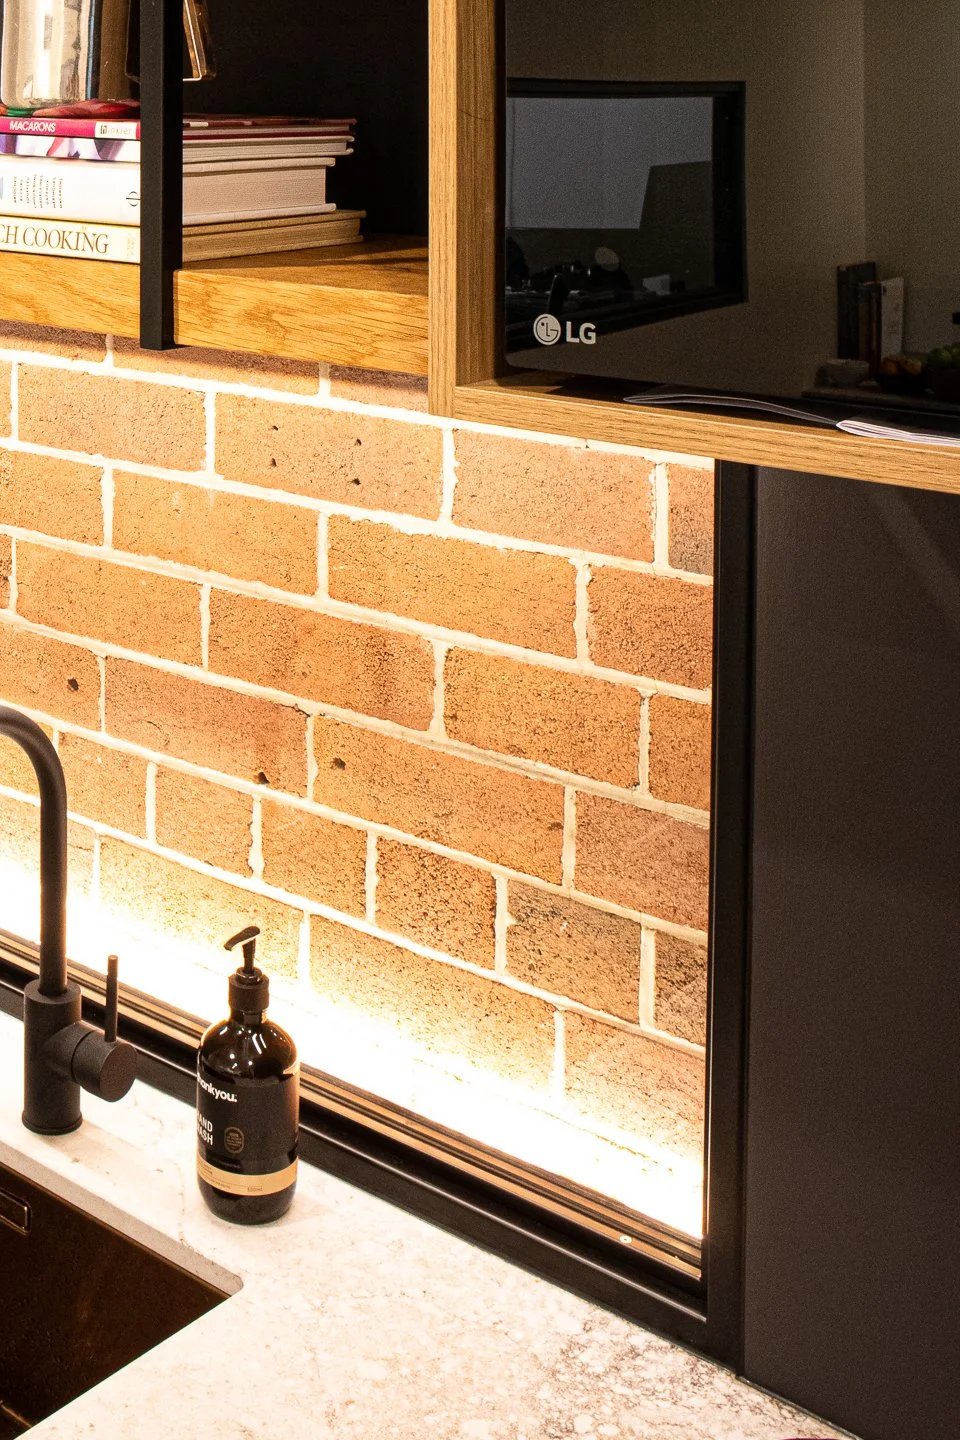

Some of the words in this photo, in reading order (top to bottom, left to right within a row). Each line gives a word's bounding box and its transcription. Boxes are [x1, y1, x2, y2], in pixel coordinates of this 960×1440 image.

[9, 120, 57, 133] MACARONS
[22, 226, 110, 254] COOKING
[565, 320, 597, 345] LG
